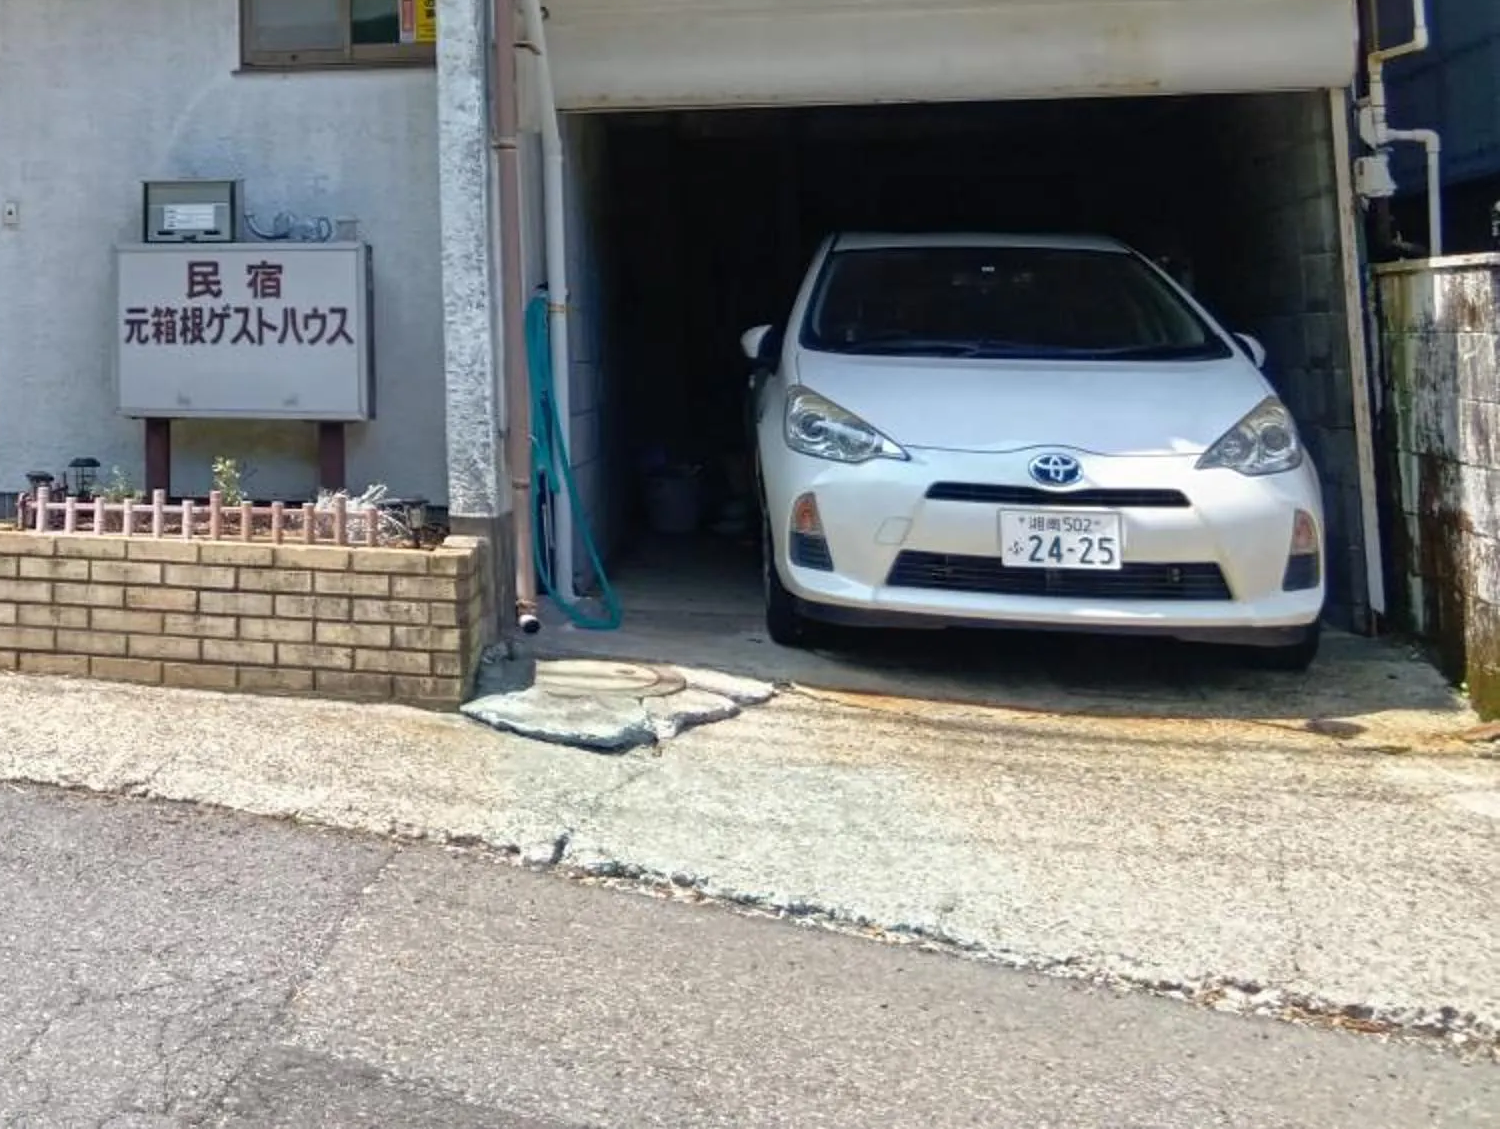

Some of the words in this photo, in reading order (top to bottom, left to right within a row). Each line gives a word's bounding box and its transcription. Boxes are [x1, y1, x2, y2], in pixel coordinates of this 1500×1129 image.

[124, 305, 354, 346] 元箱根ゲストハウス
[1028, 534, 1115, 565] 24-25
